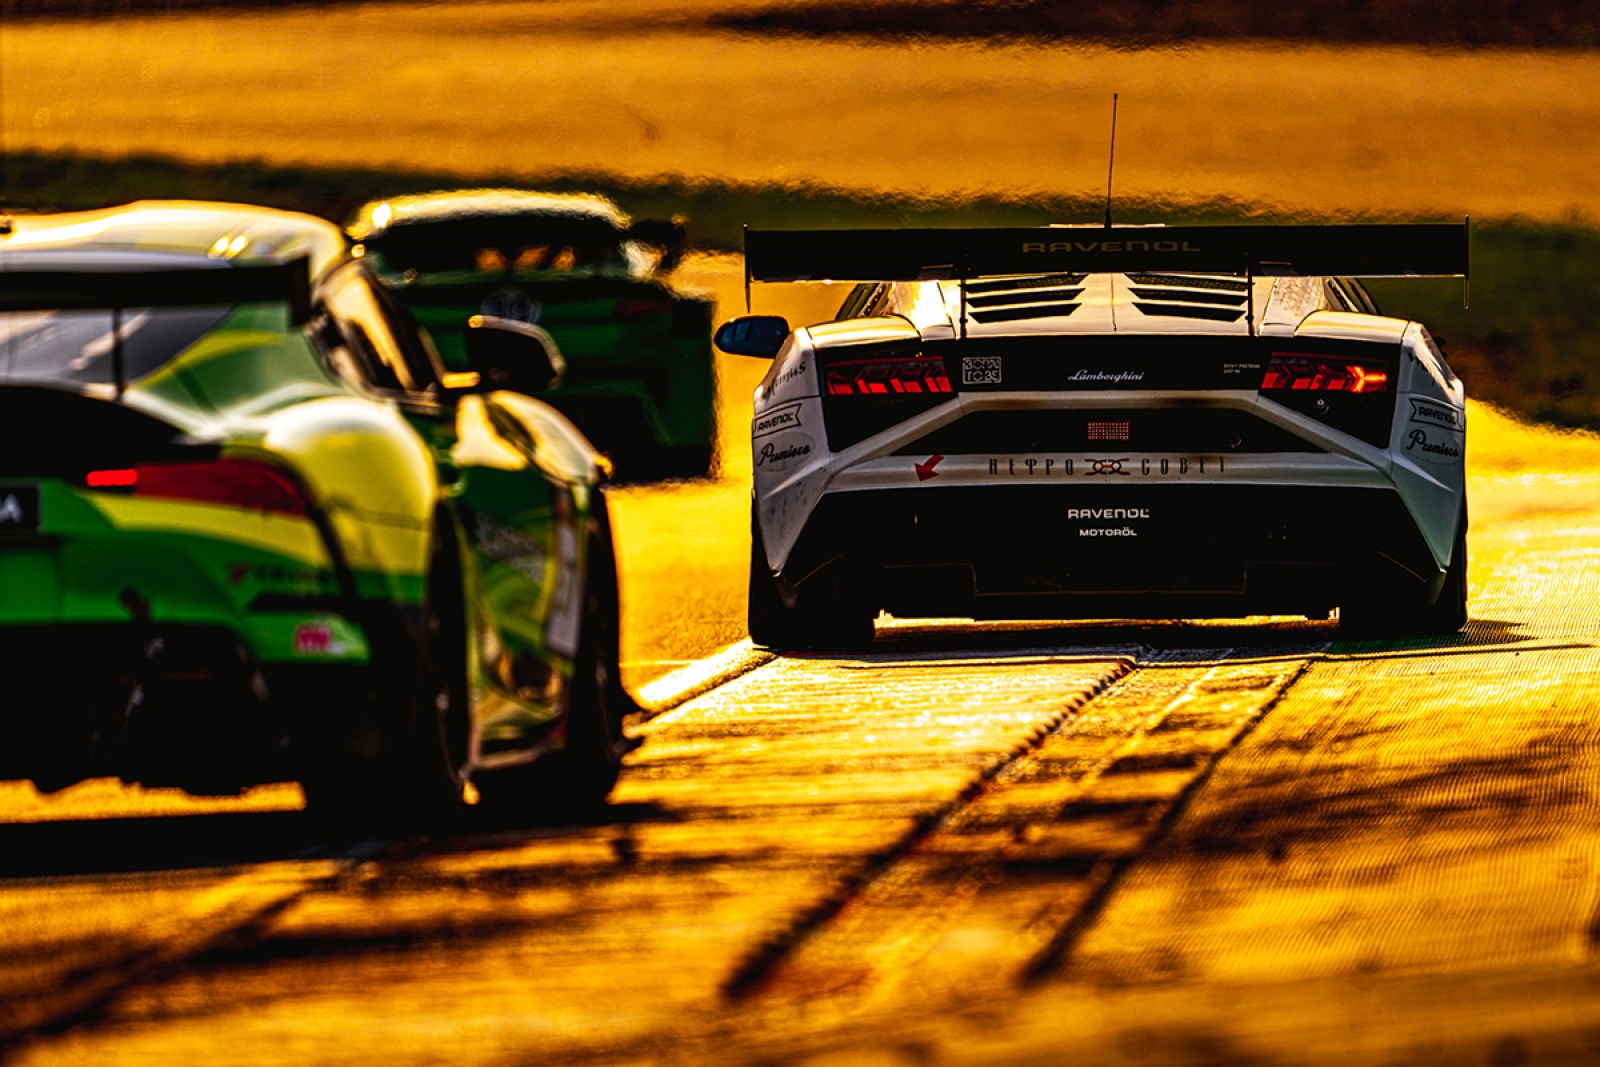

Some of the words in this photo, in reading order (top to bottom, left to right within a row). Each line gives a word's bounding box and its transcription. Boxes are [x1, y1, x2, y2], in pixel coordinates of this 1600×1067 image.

[1022, 241, 1201, 253] RAVENOL
[1067, 368, 1145, 384] Lamborghini
[1418, 406, 1457, 425] RAVENOL
[1079, 526, 1138, 537] MOTORÖL
